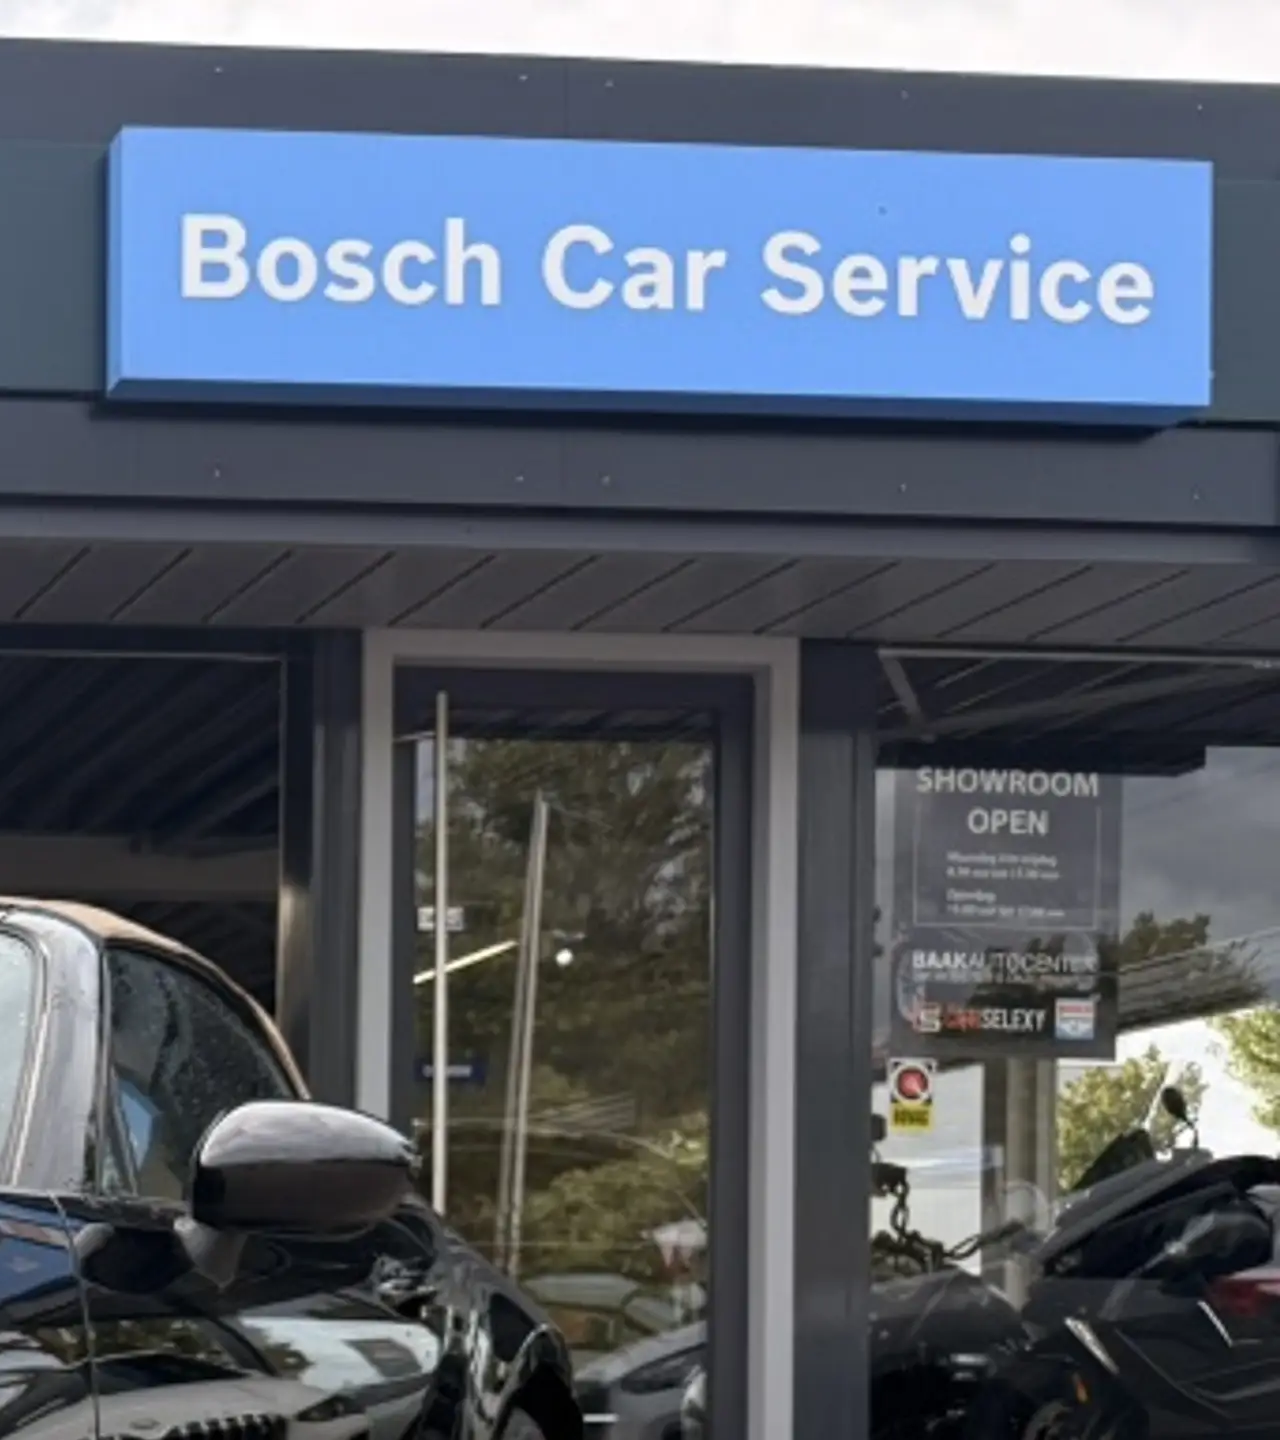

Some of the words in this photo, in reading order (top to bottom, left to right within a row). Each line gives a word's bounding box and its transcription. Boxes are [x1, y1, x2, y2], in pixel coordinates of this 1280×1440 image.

[179, 213, 501, 305] Bosch
[542, 224, 727, 310] Car
[759, 231, 1154, 324] Service
[915, 767, 1099, 798] SHOWROOM
[967, 808, 1049, 836] OPEN
